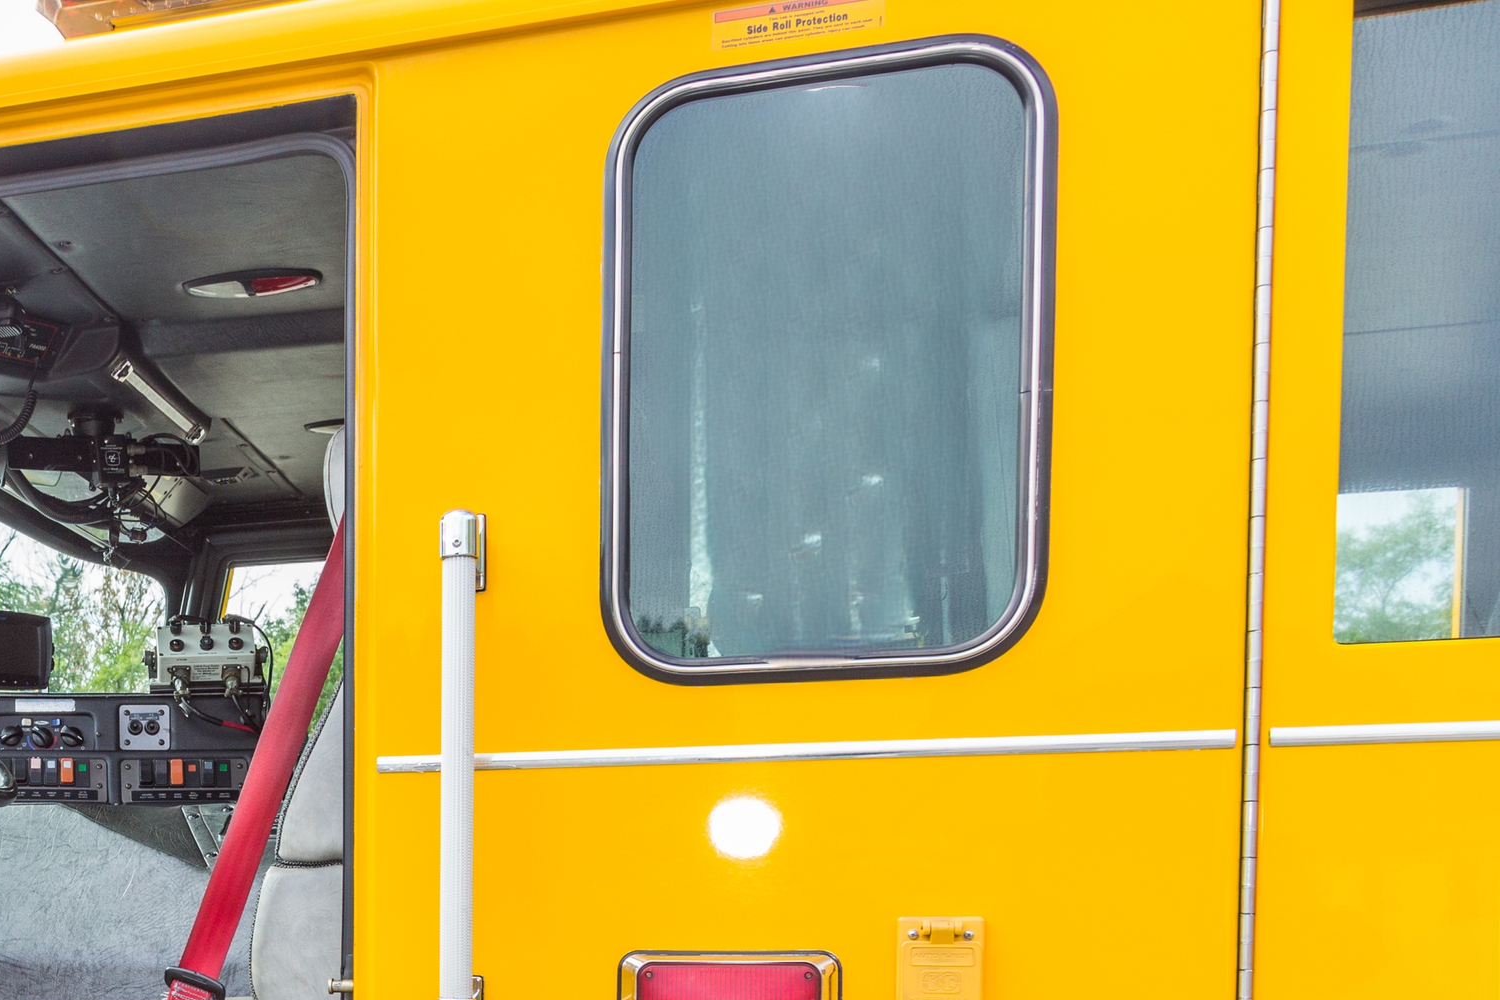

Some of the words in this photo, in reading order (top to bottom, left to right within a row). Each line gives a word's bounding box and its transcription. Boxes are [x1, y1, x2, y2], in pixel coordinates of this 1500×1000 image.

[783, 0, 828, 11] WARNING
[747, 24, 768, 35] Side
[772, 20, 791, 31] Roll
[795, 13, 848, 27] Protection
